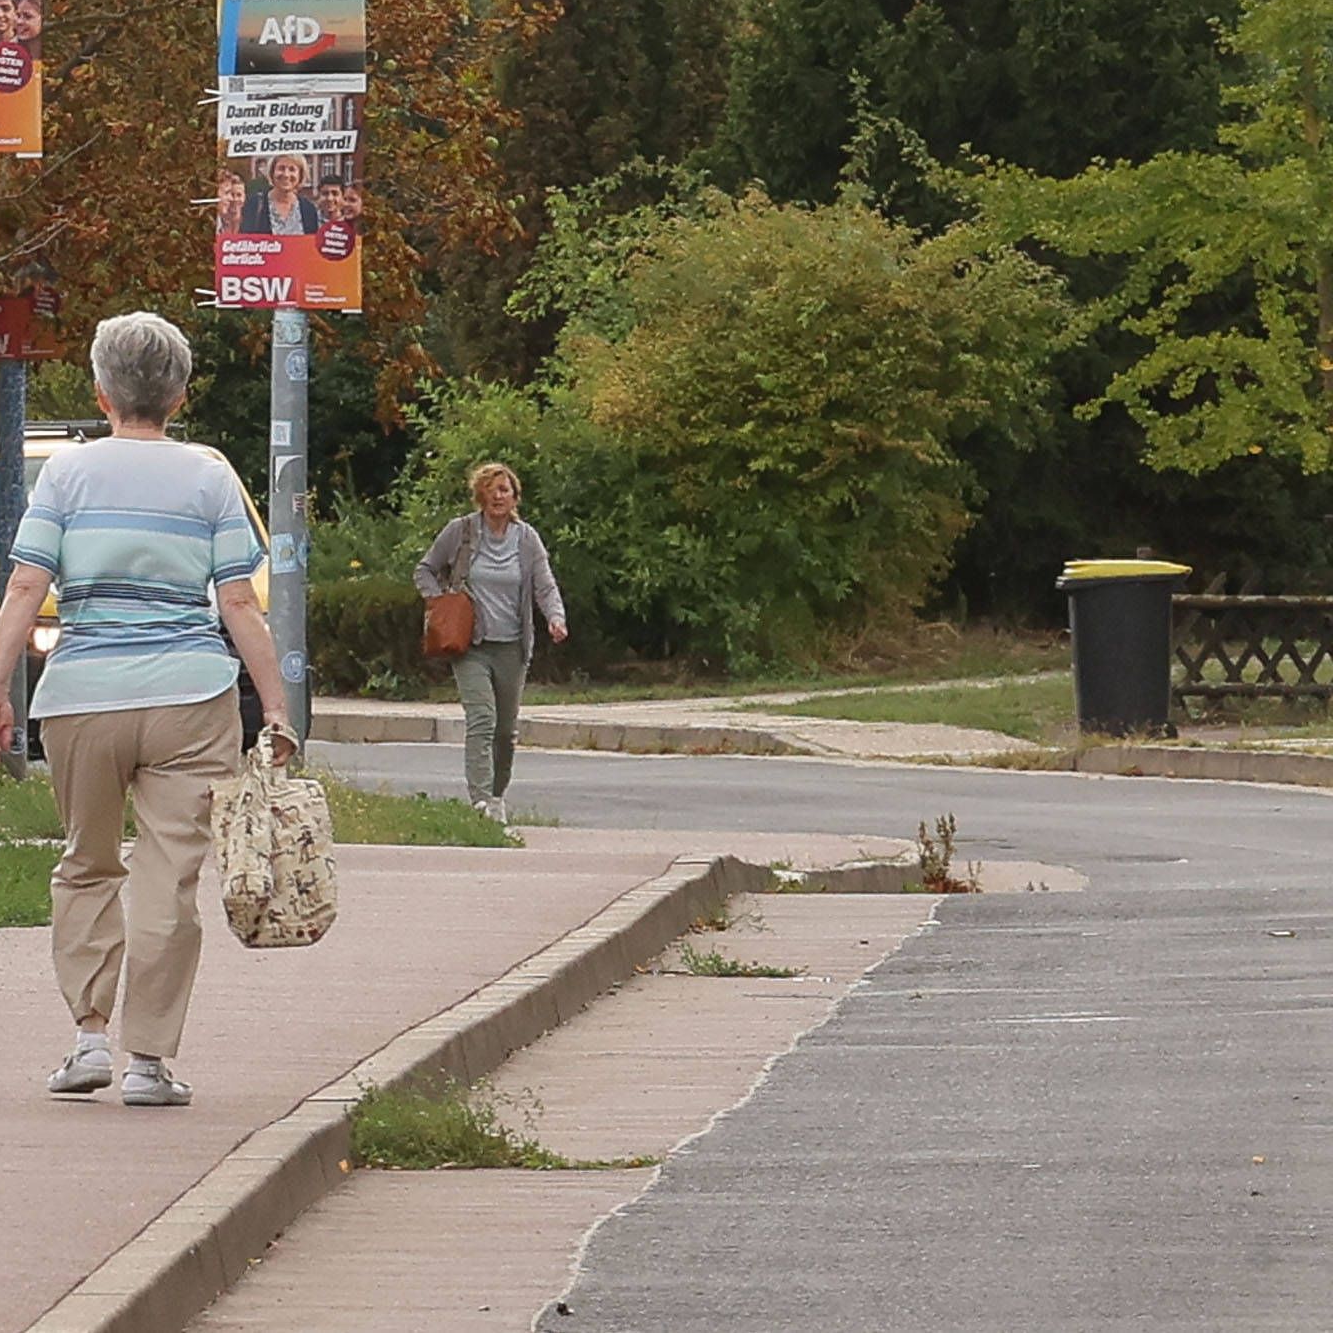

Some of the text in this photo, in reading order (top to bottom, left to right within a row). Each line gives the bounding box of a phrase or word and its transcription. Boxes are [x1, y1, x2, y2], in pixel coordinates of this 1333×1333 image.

[258, 16, 321, 45] AfD
[226, 103, 324, 118] Damit Bildung
[230, 119, 316, 135] wieder Stolz
[234, 135, 351, 153] des Ostens wird!
[221, 277, 292, 303] BSW
